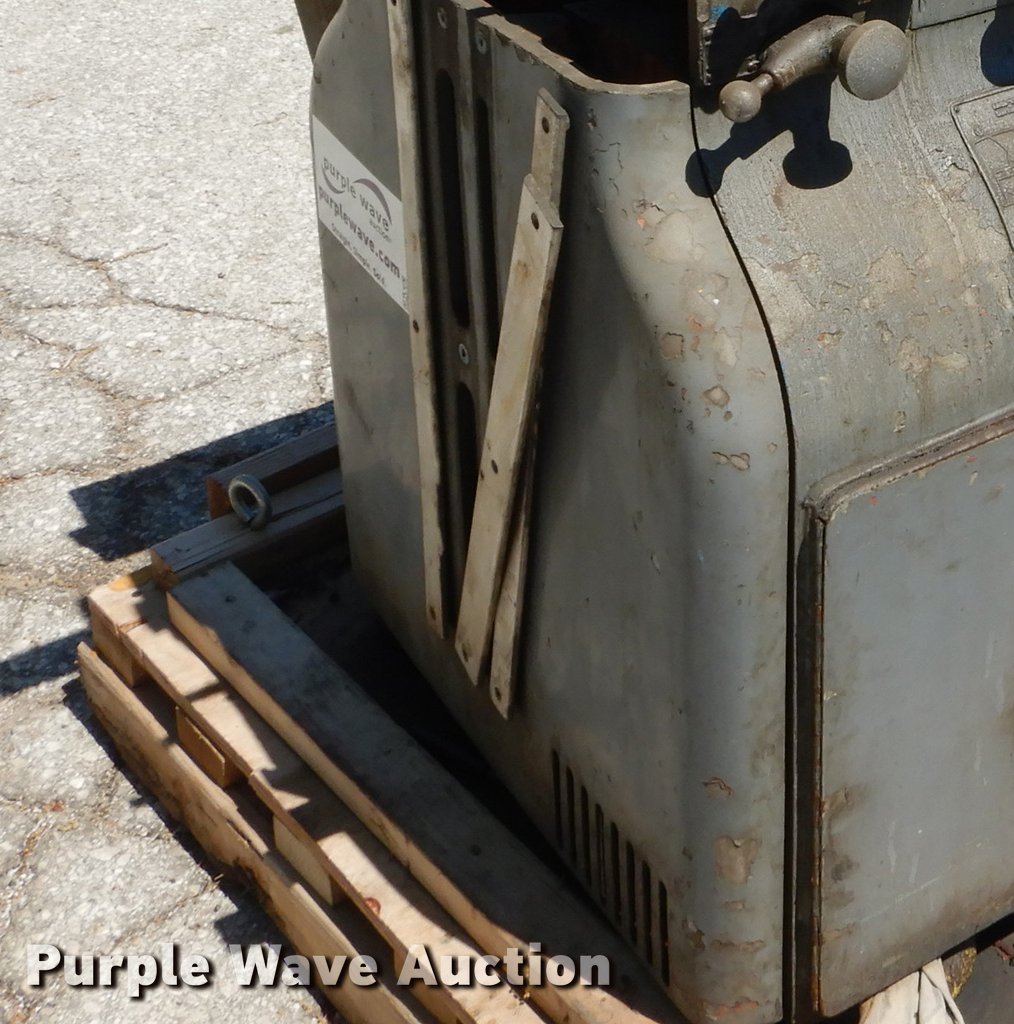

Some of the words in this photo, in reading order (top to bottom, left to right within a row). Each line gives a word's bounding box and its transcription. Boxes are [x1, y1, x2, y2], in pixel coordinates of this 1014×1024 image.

[318, 184, 400, 279] purplewave.com
[323, 157, 357, 199] purple
[360, 194, 389, 232] wave
